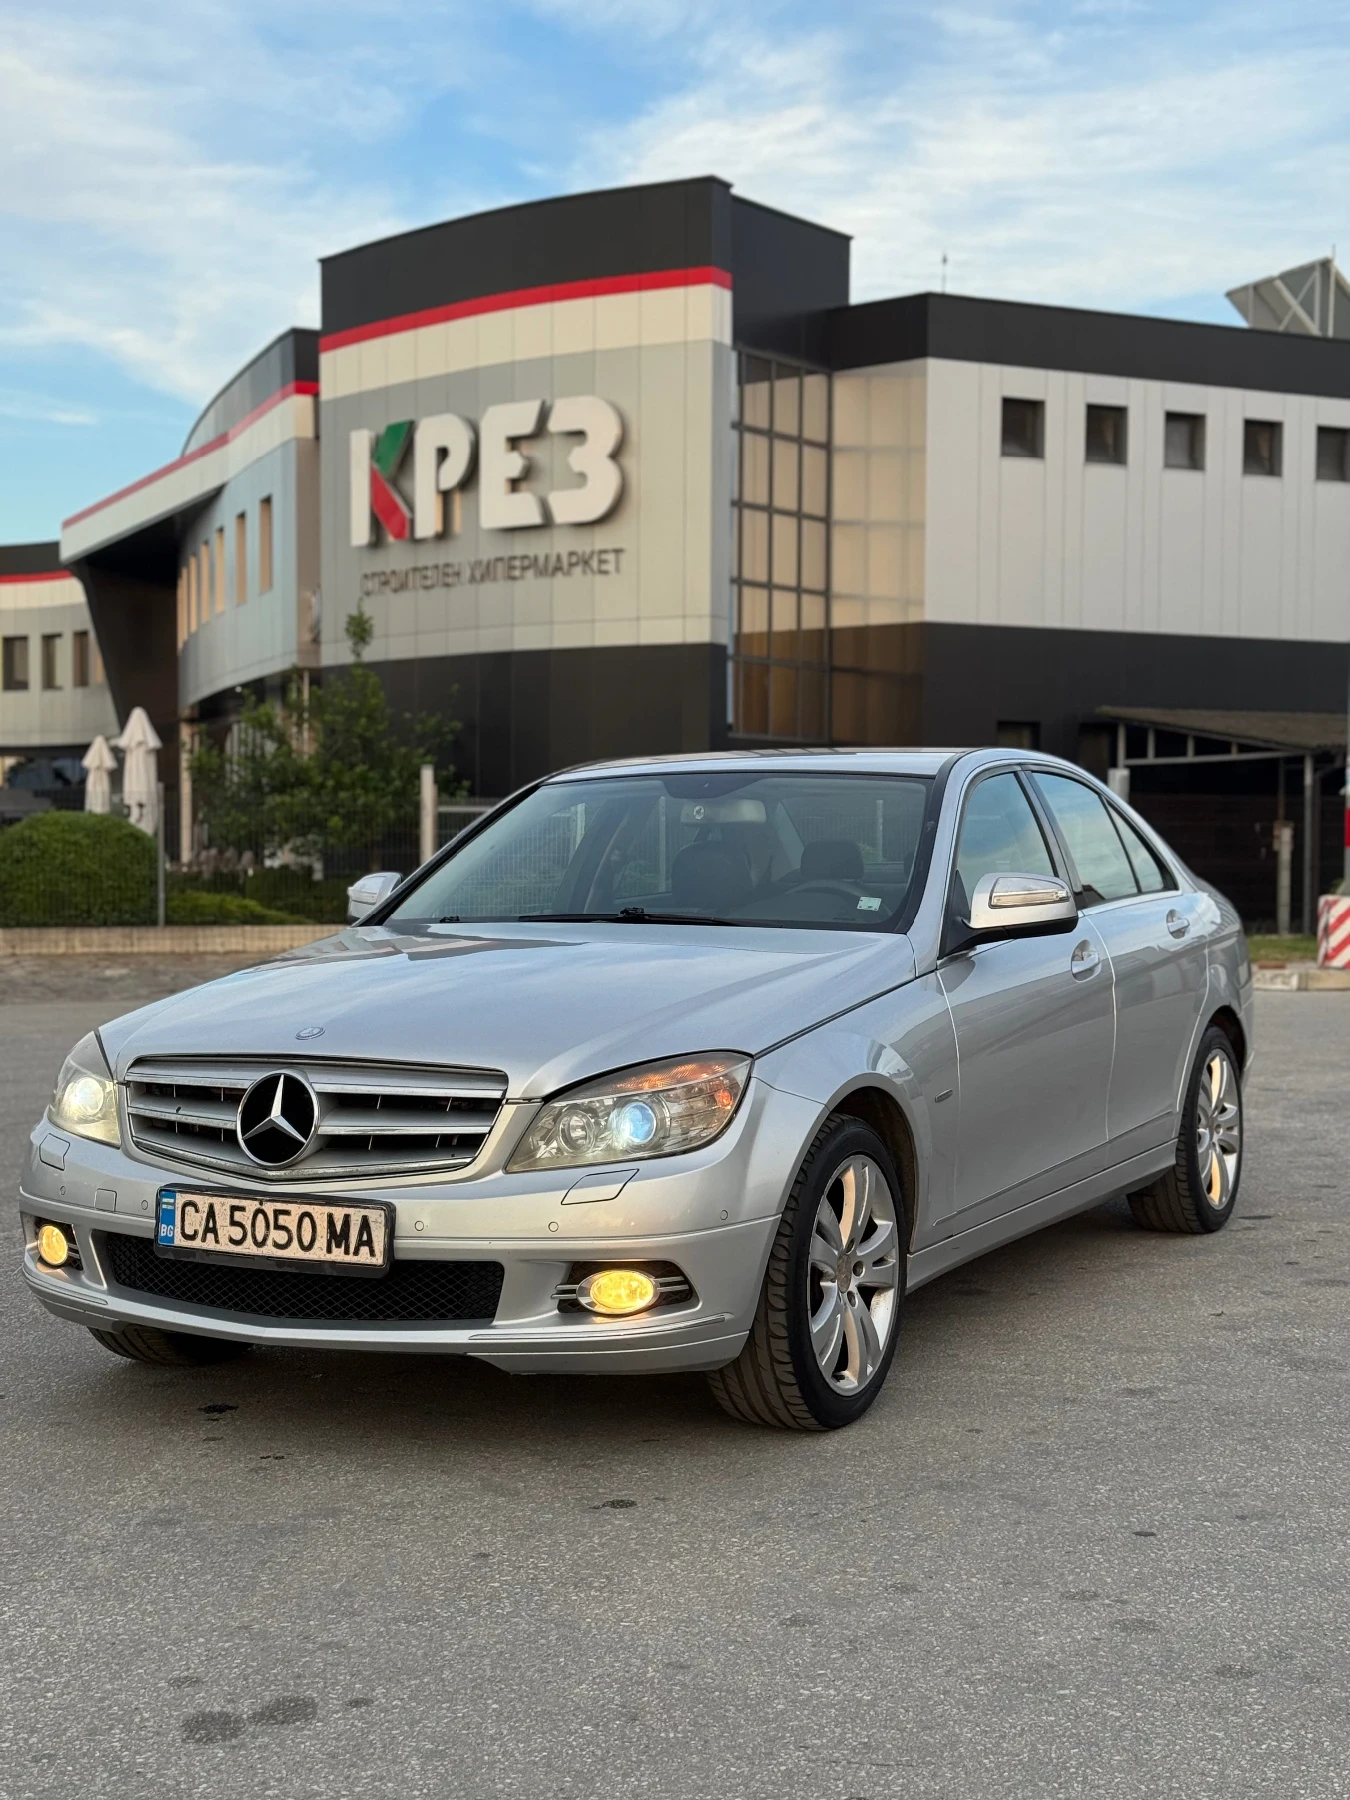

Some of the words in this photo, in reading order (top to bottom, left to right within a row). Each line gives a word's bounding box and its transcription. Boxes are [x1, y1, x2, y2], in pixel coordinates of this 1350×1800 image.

[350, 395, 623, 547] КРЕЗ
[362, 561, 461, 597] СТРОИТЕЛЕН
[468, 548, 625, 585] ХИПЕРМАРКЕТ
[160, 1223, 174, 1237] BG
